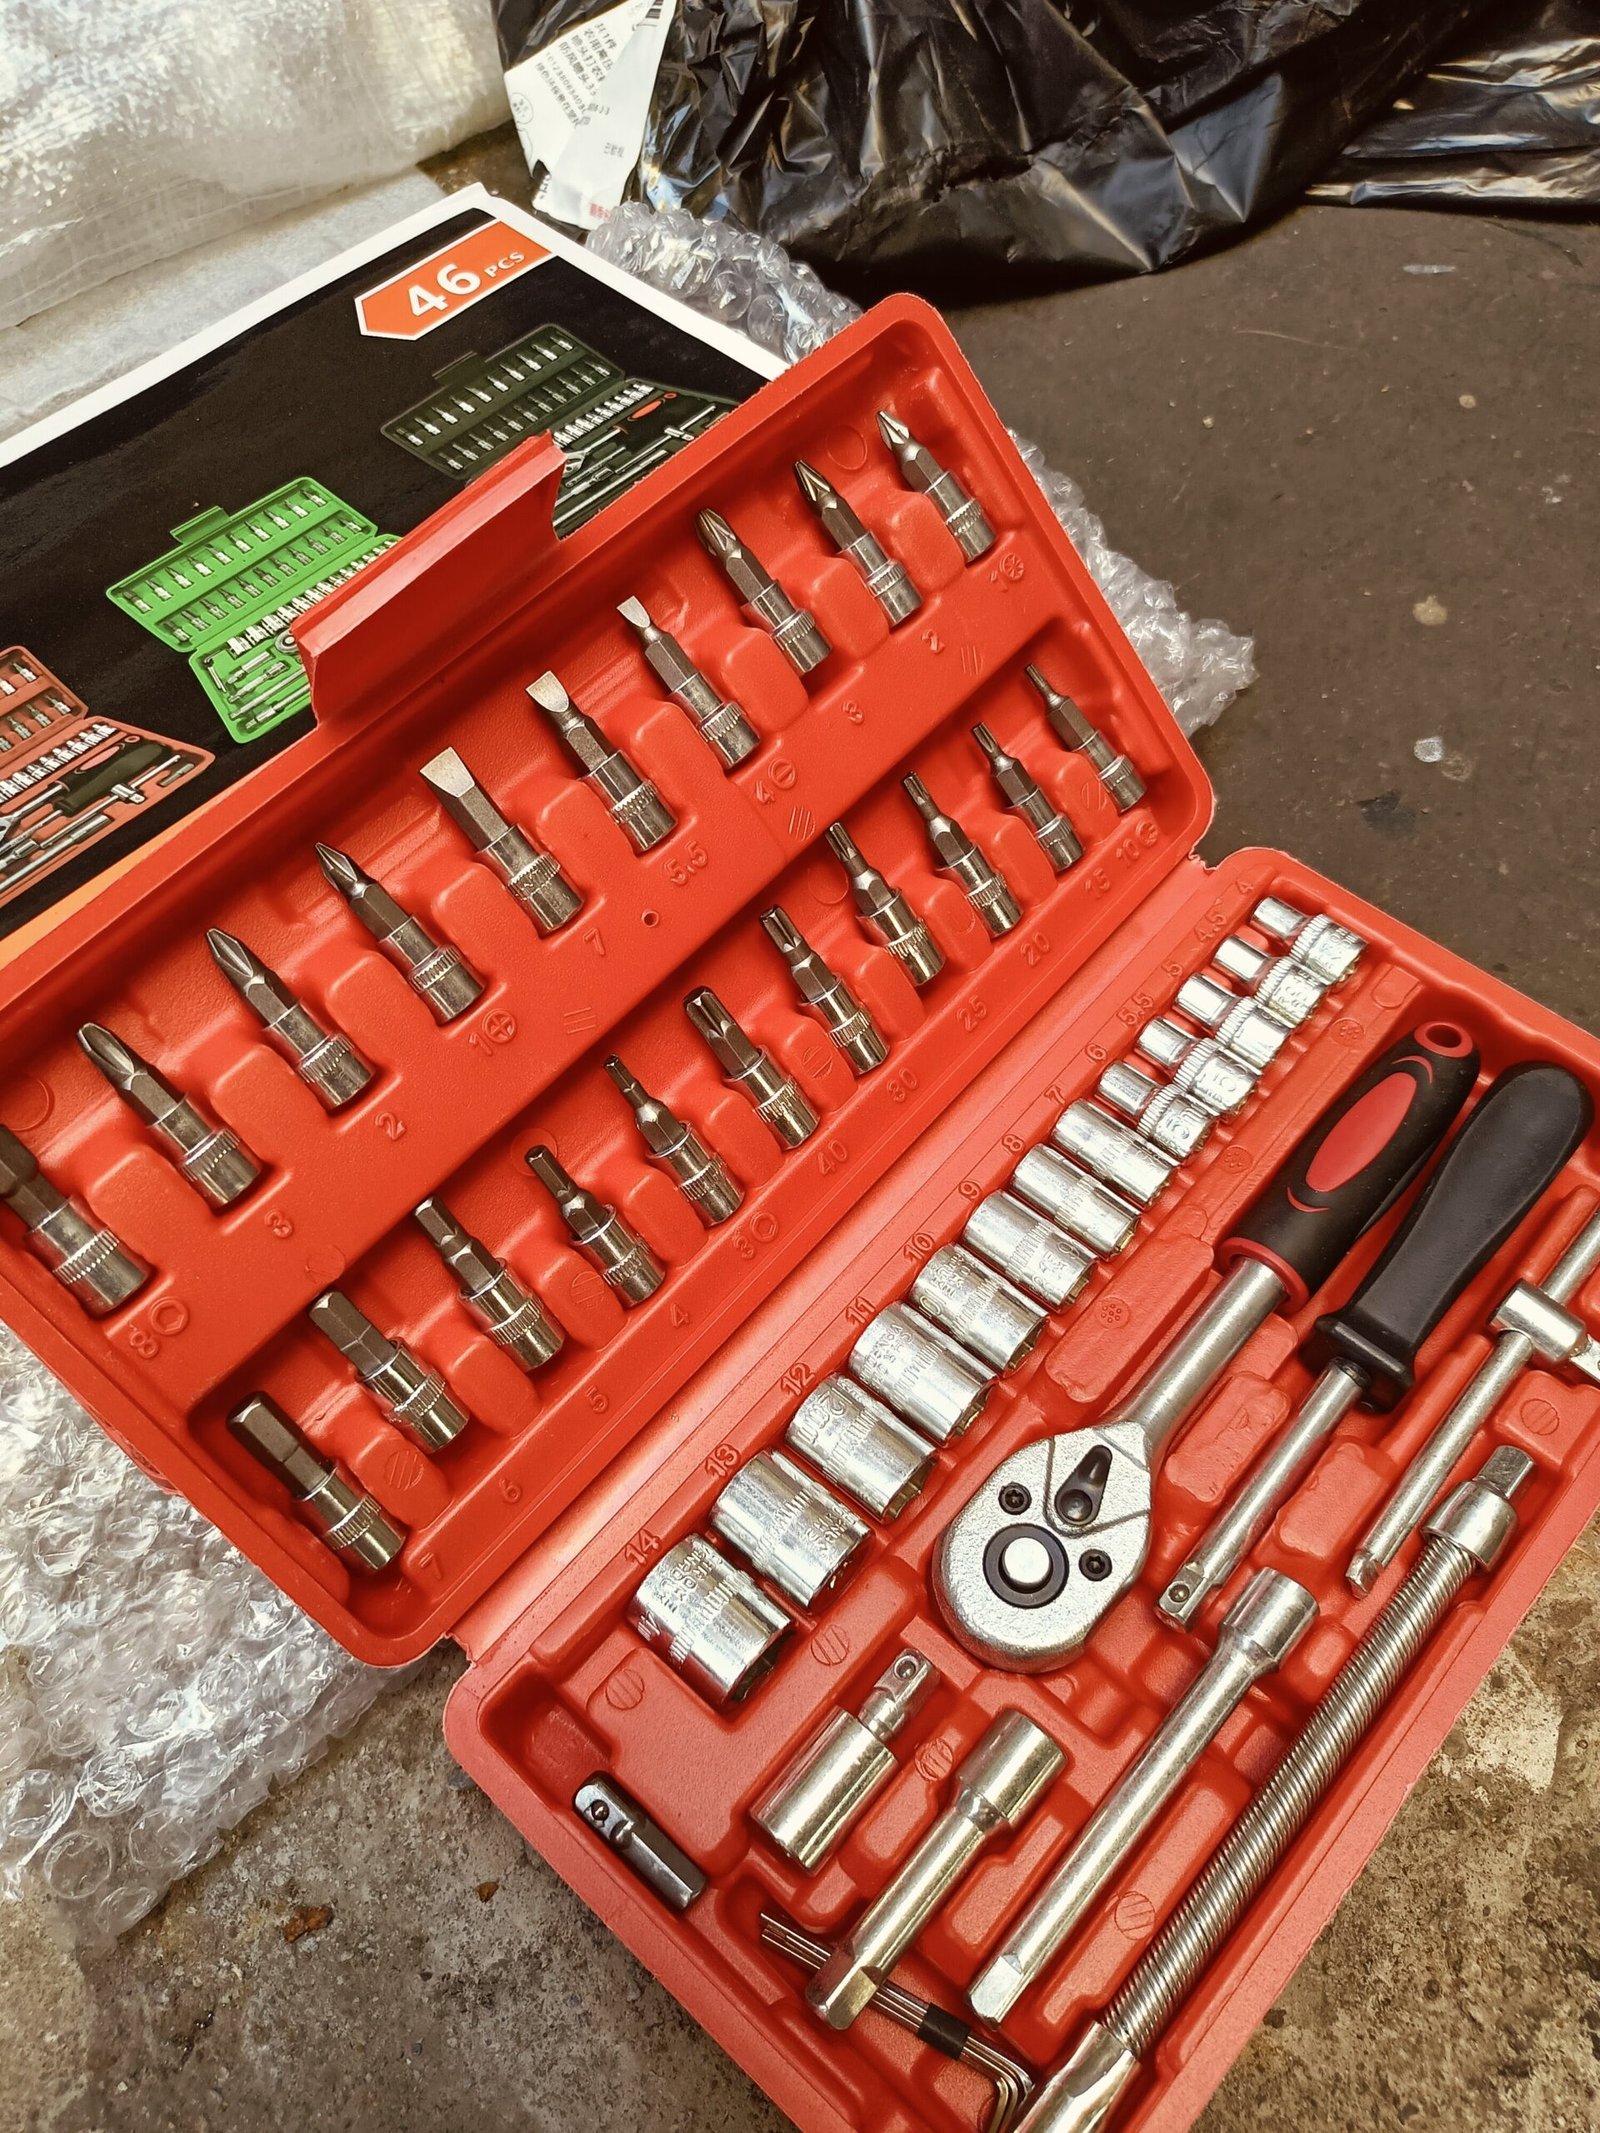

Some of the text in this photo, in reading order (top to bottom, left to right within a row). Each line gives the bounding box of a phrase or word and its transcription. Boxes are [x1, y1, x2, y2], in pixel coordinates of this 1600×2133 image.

[408, 252, 525, 315] 46 PCS
[921, 629, 945, 654] 2
[754, 780, 776, 805] 4
[663, 840, 709, 886] 5.5
[1236, 879, 1255, 897] 4
[1193, 909, 1228, 943] 4.5
[583, 927, 606, 957] 7
[1020, 932, 1051, 968] 20
[1162, 960, 1183, 978] 5
[955, 995, 987, 1032] 25
[1116, 994, 1154, 1026] 5.5
[468, 1031, 493, 1057] 1
[1084, 1042, 1108, 1063] 6
[886, 1068, 919, 1103] 30
[1044, 1085, 1066, 1107] 7
[375, 1112, 407, 1141] 2
[817, 1139, 848, 1176] 40
[1001, 1133, 1025, 1155] 8
[958, 1180, 982, 1201] 9
[264, 1208, 294, 1239] 3
[903, 1232, 935, 1263] 10
[669, 1306, 690, 1329] 4
[845, 1296, 876, 1328] 11
[780, 1362, 816, 1397] 12
[586, 1389, 610, 1414] 5
[704, 1443, 742, 1478] 13
[499, 1478, 523, 1504] 6
[624, 1528, 662, 1566] 14
[419, 1553, 445, 1580] 7
